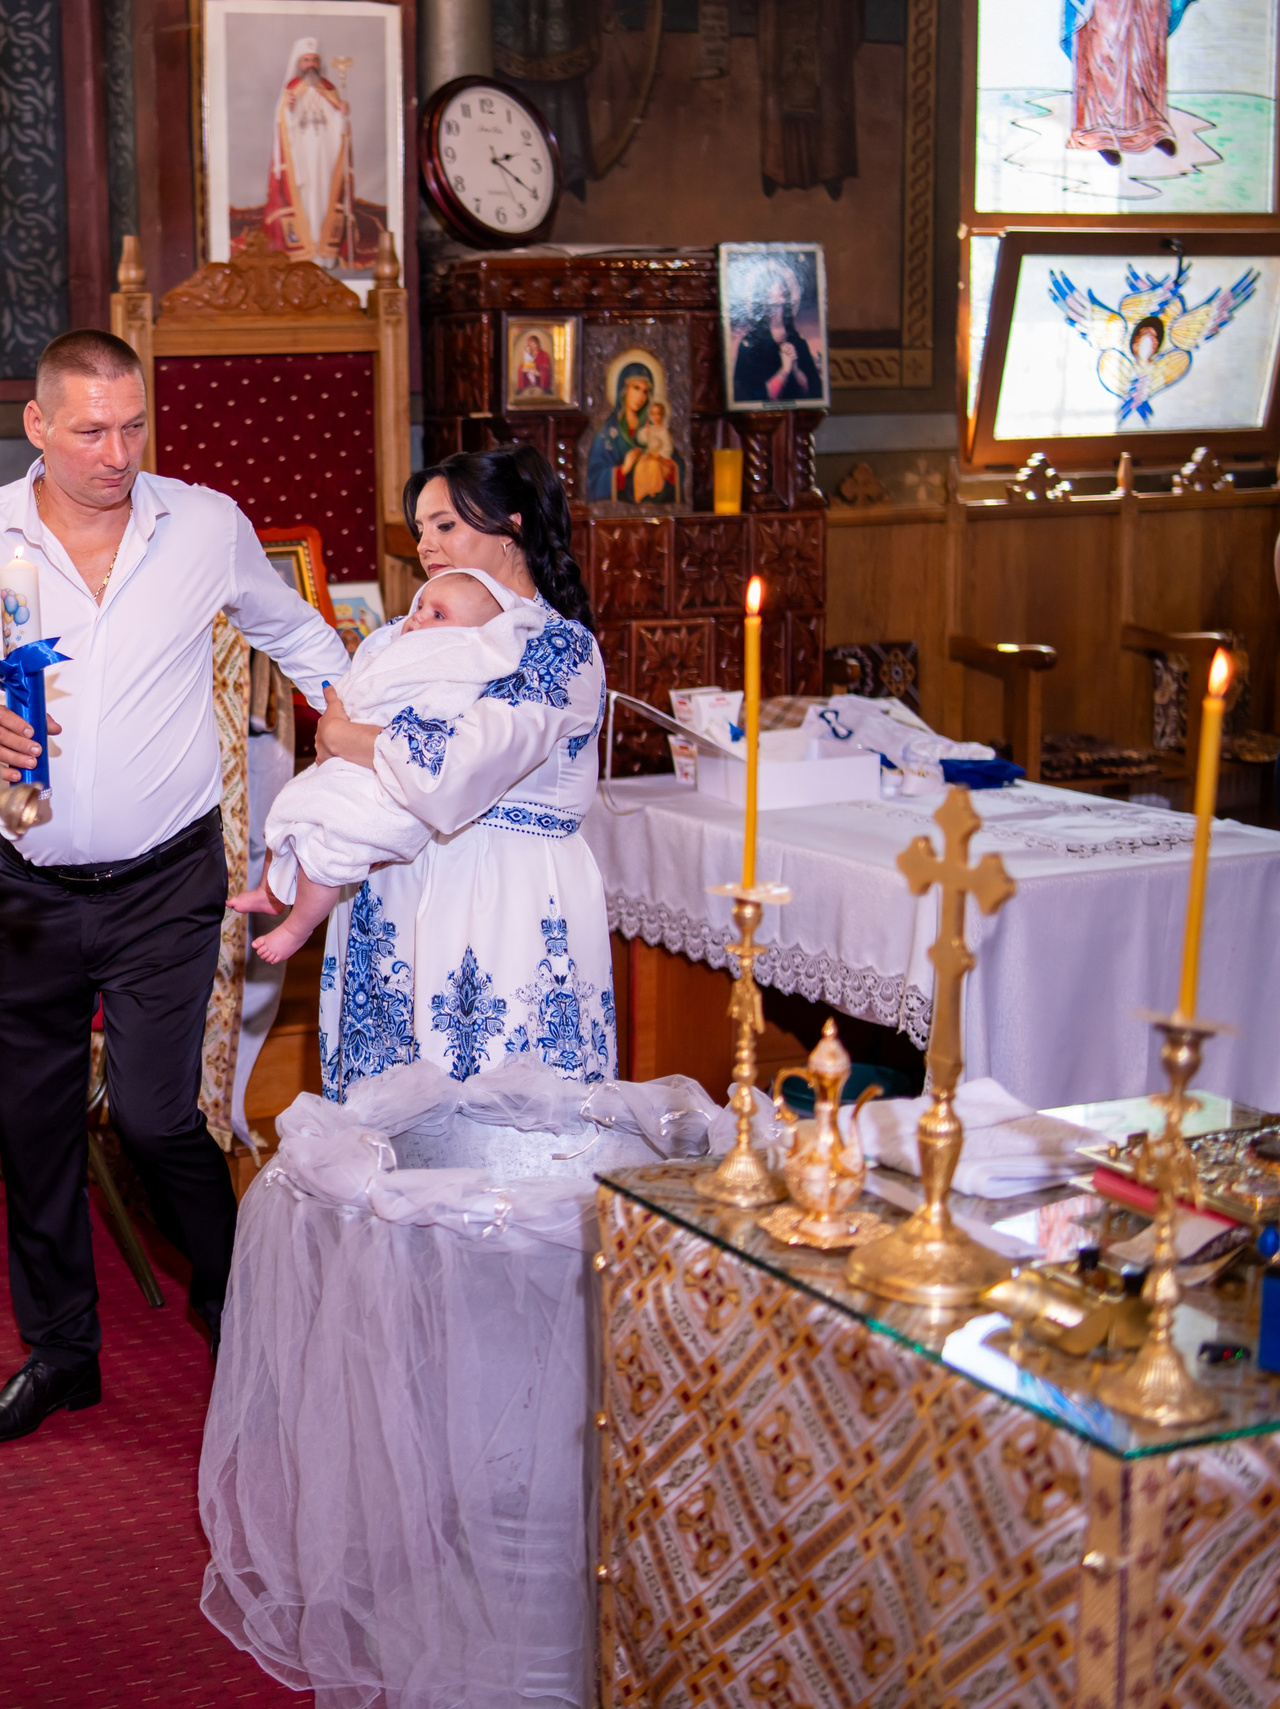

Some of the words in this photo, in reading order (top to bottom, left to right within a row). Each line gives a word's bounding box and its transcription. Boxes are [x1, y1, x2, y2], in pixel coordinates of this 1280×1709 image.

[461, 103, 471, 118] 11
[480, 98, 495, 114] 12
[506, 109, 512, 124] 1
[445, 120, 460, 136] 10
[521, 130, 532, 147] 2
[444, 146, 456, 164] 9
[531, 158, 542, 175] 3
[454, 175, 465, 193] 8
[474, 198, 481, 214] 7
[495, 206, 507, 225] 6
